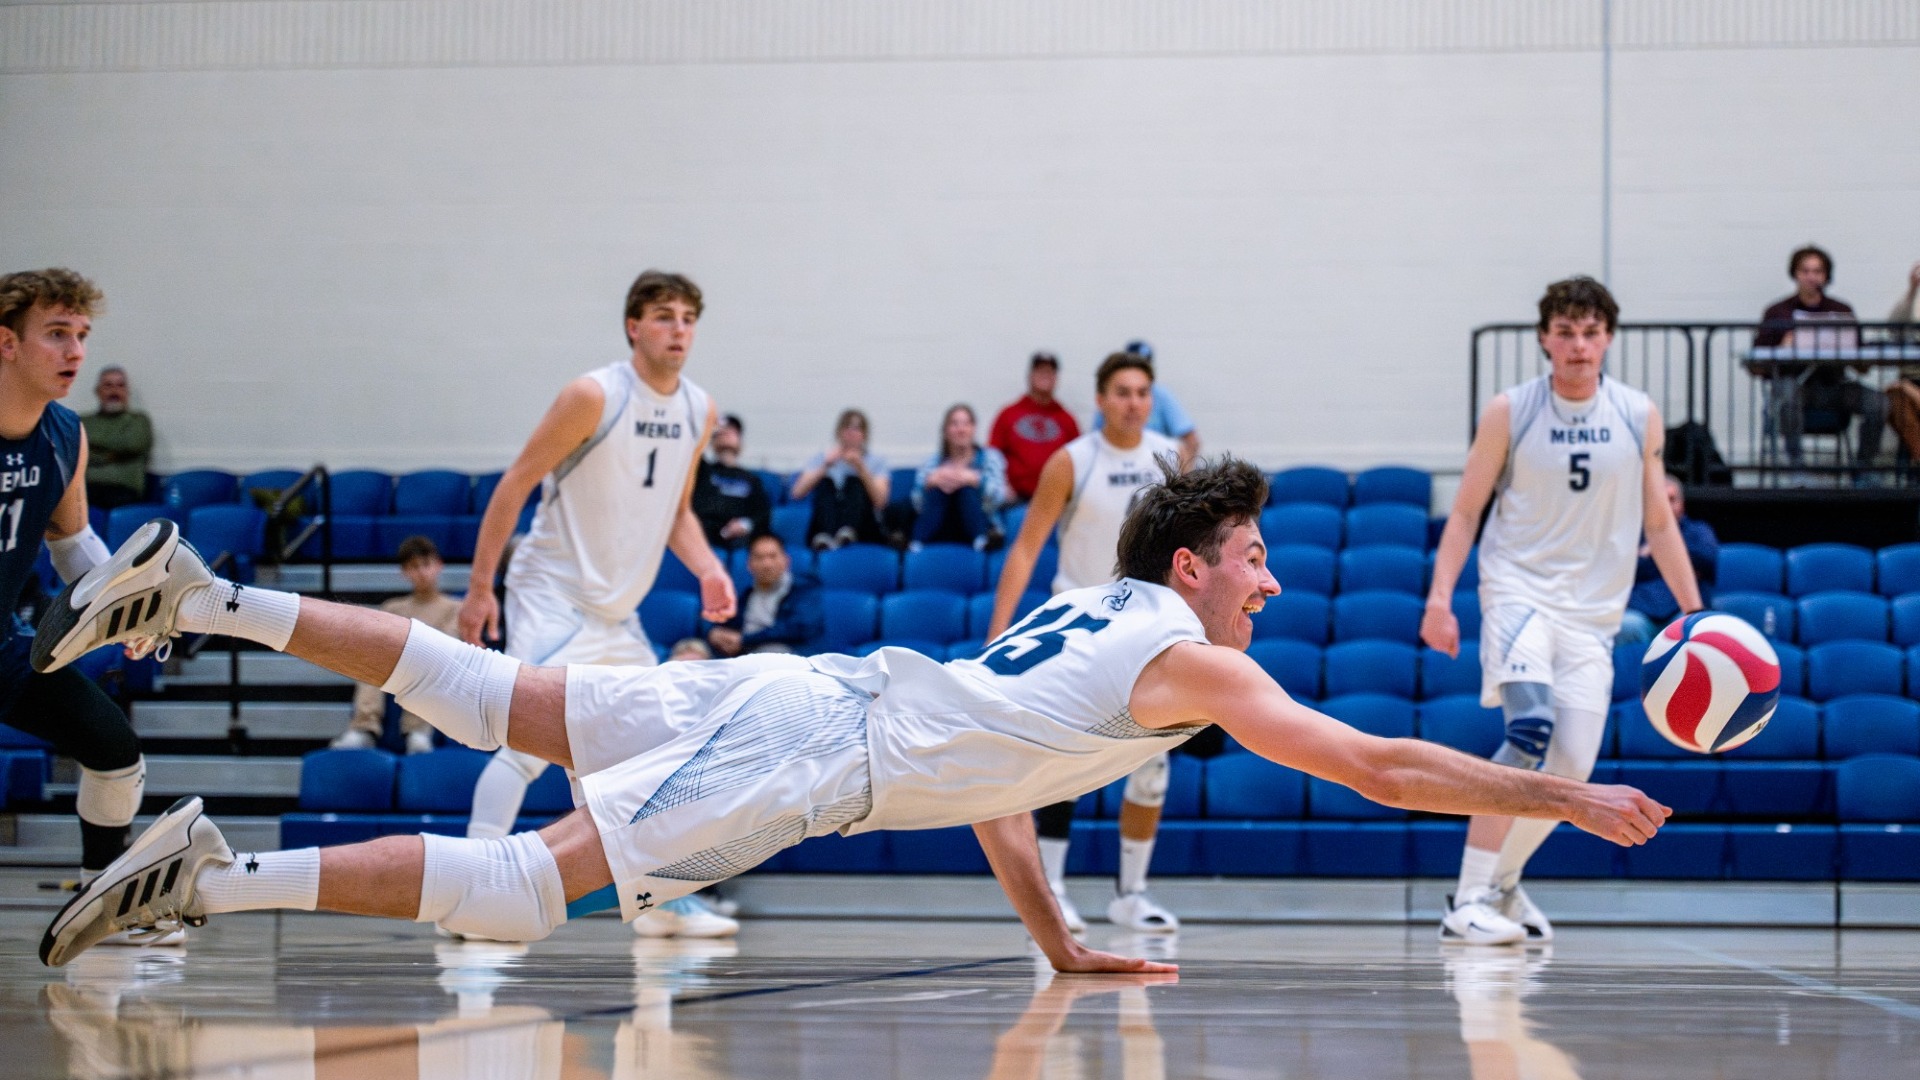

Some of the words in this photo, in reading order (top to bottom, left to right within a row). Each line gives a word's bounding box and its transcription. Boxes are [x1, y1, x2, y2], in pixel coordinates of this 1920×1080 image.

[635, 421, 681, 439] MENLO
[1550, 428, 1611, 444] MENLO
[642, 447, 658, 488] 1
[1569, 452, 1591, 492] 5
[966, 603, 1111, 676] 15
